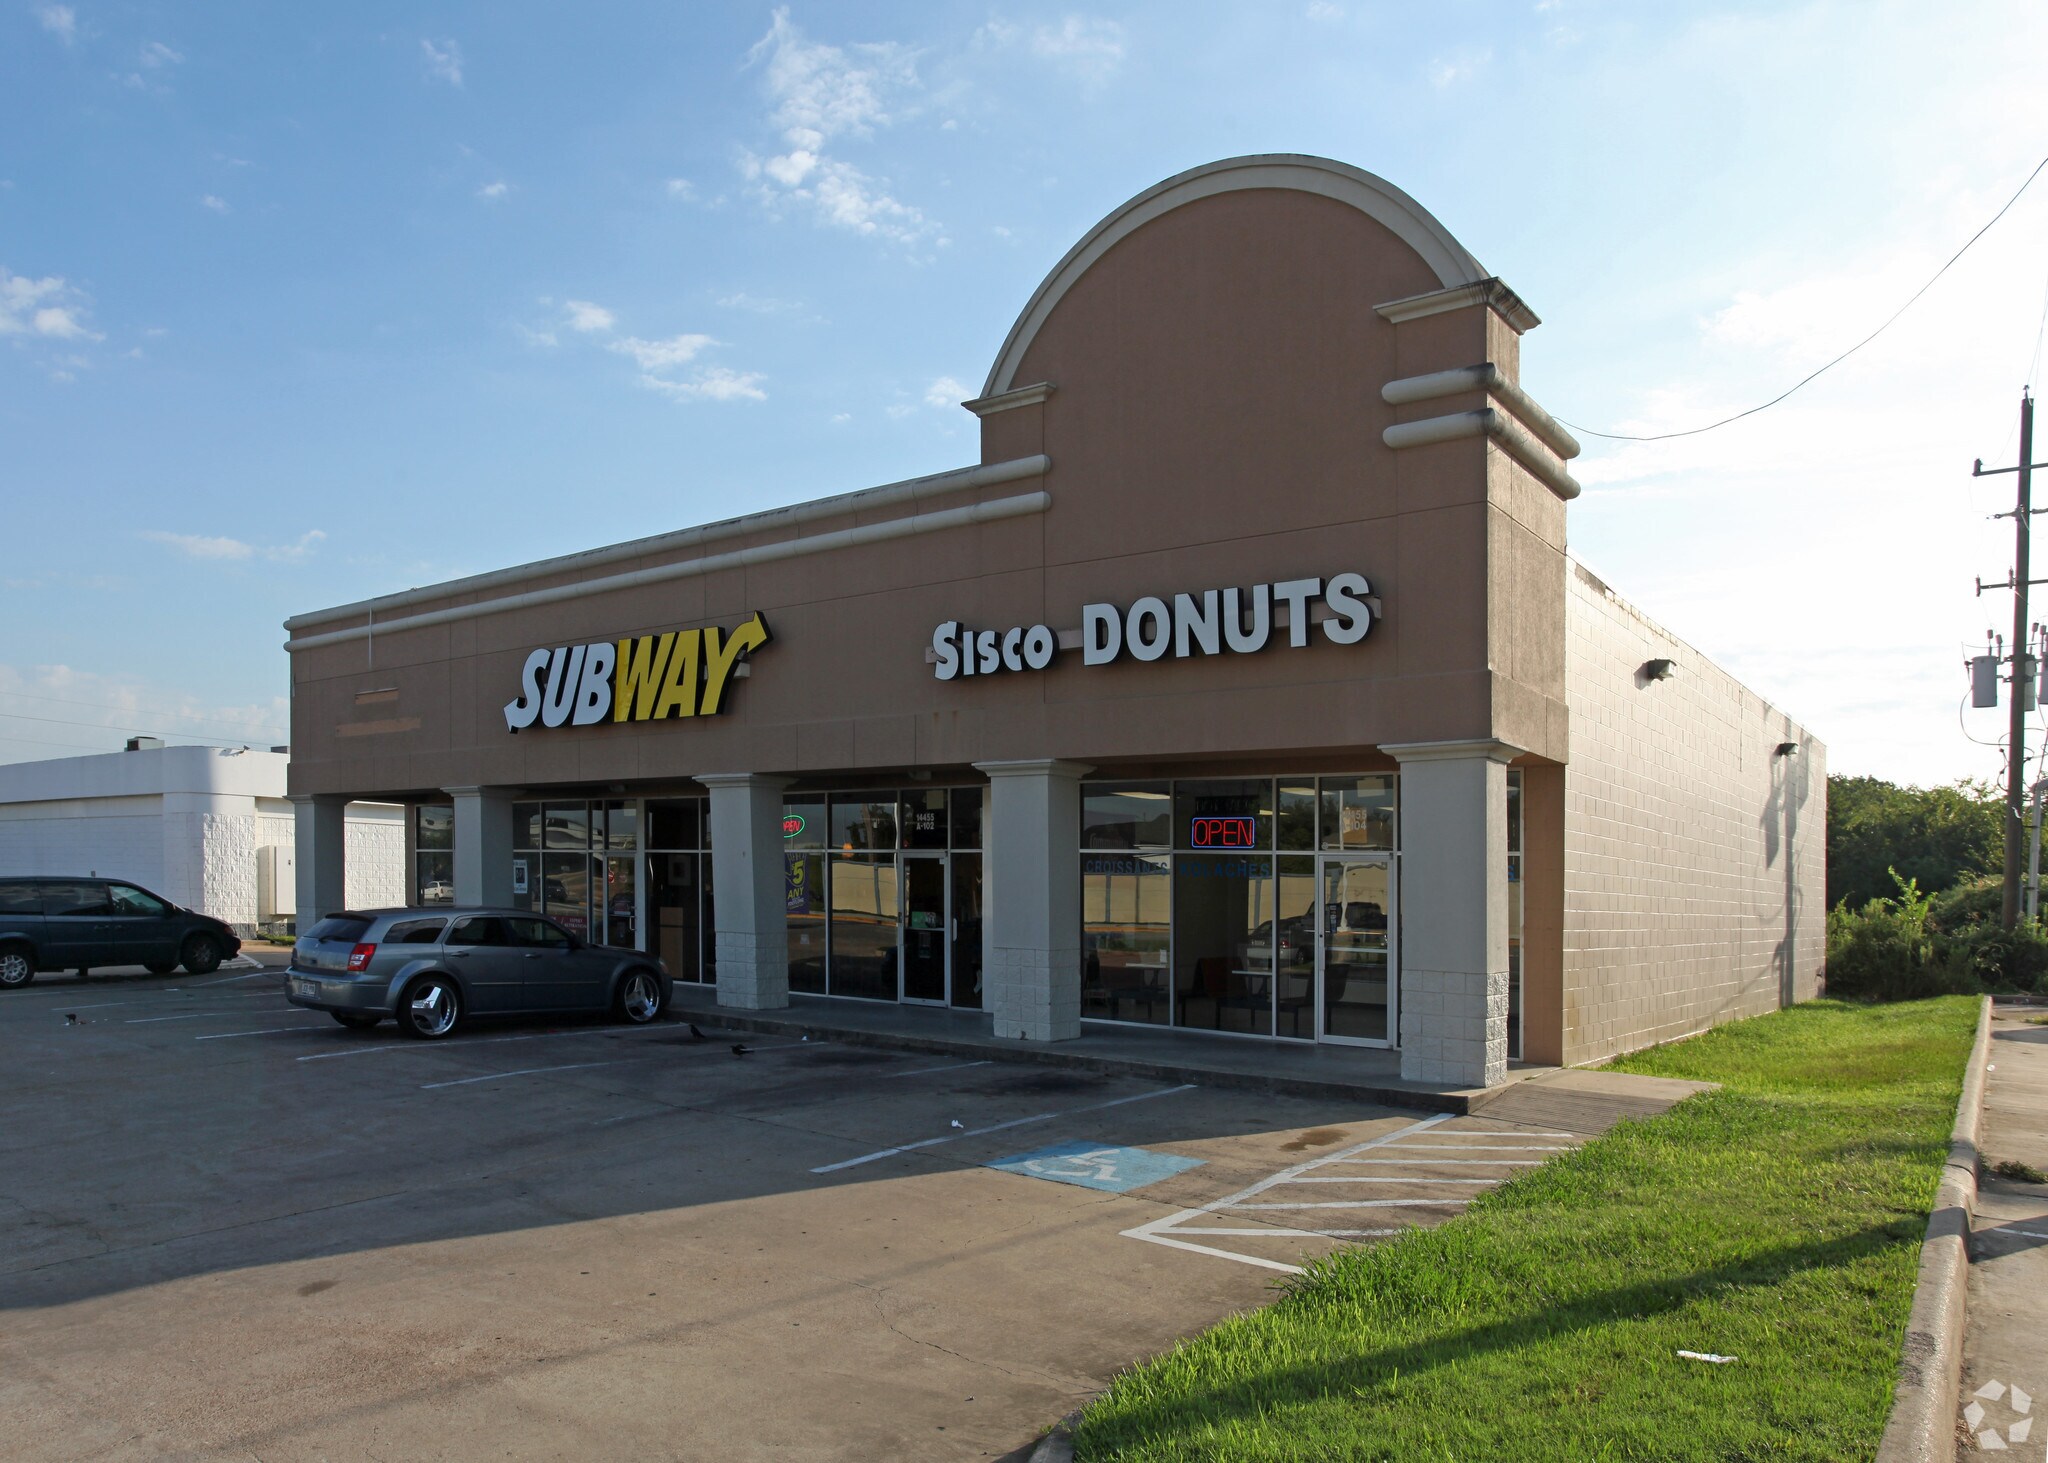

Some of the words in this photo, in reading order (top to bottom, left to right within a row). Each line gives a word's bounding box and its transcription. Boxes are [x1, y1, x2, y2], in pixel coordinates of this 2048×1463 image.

[1082, 572, 1375, 667] DONUTS
[503, 610, 774, 734] SUBWAY
[916, 813, 934, 821] 14455
[783, 820, 801, 832] PEN
[916, 822, 934, 830] A-102
[1194, 820, 1252, 845] OPEN
[787, 886, 804, 899] ANY
